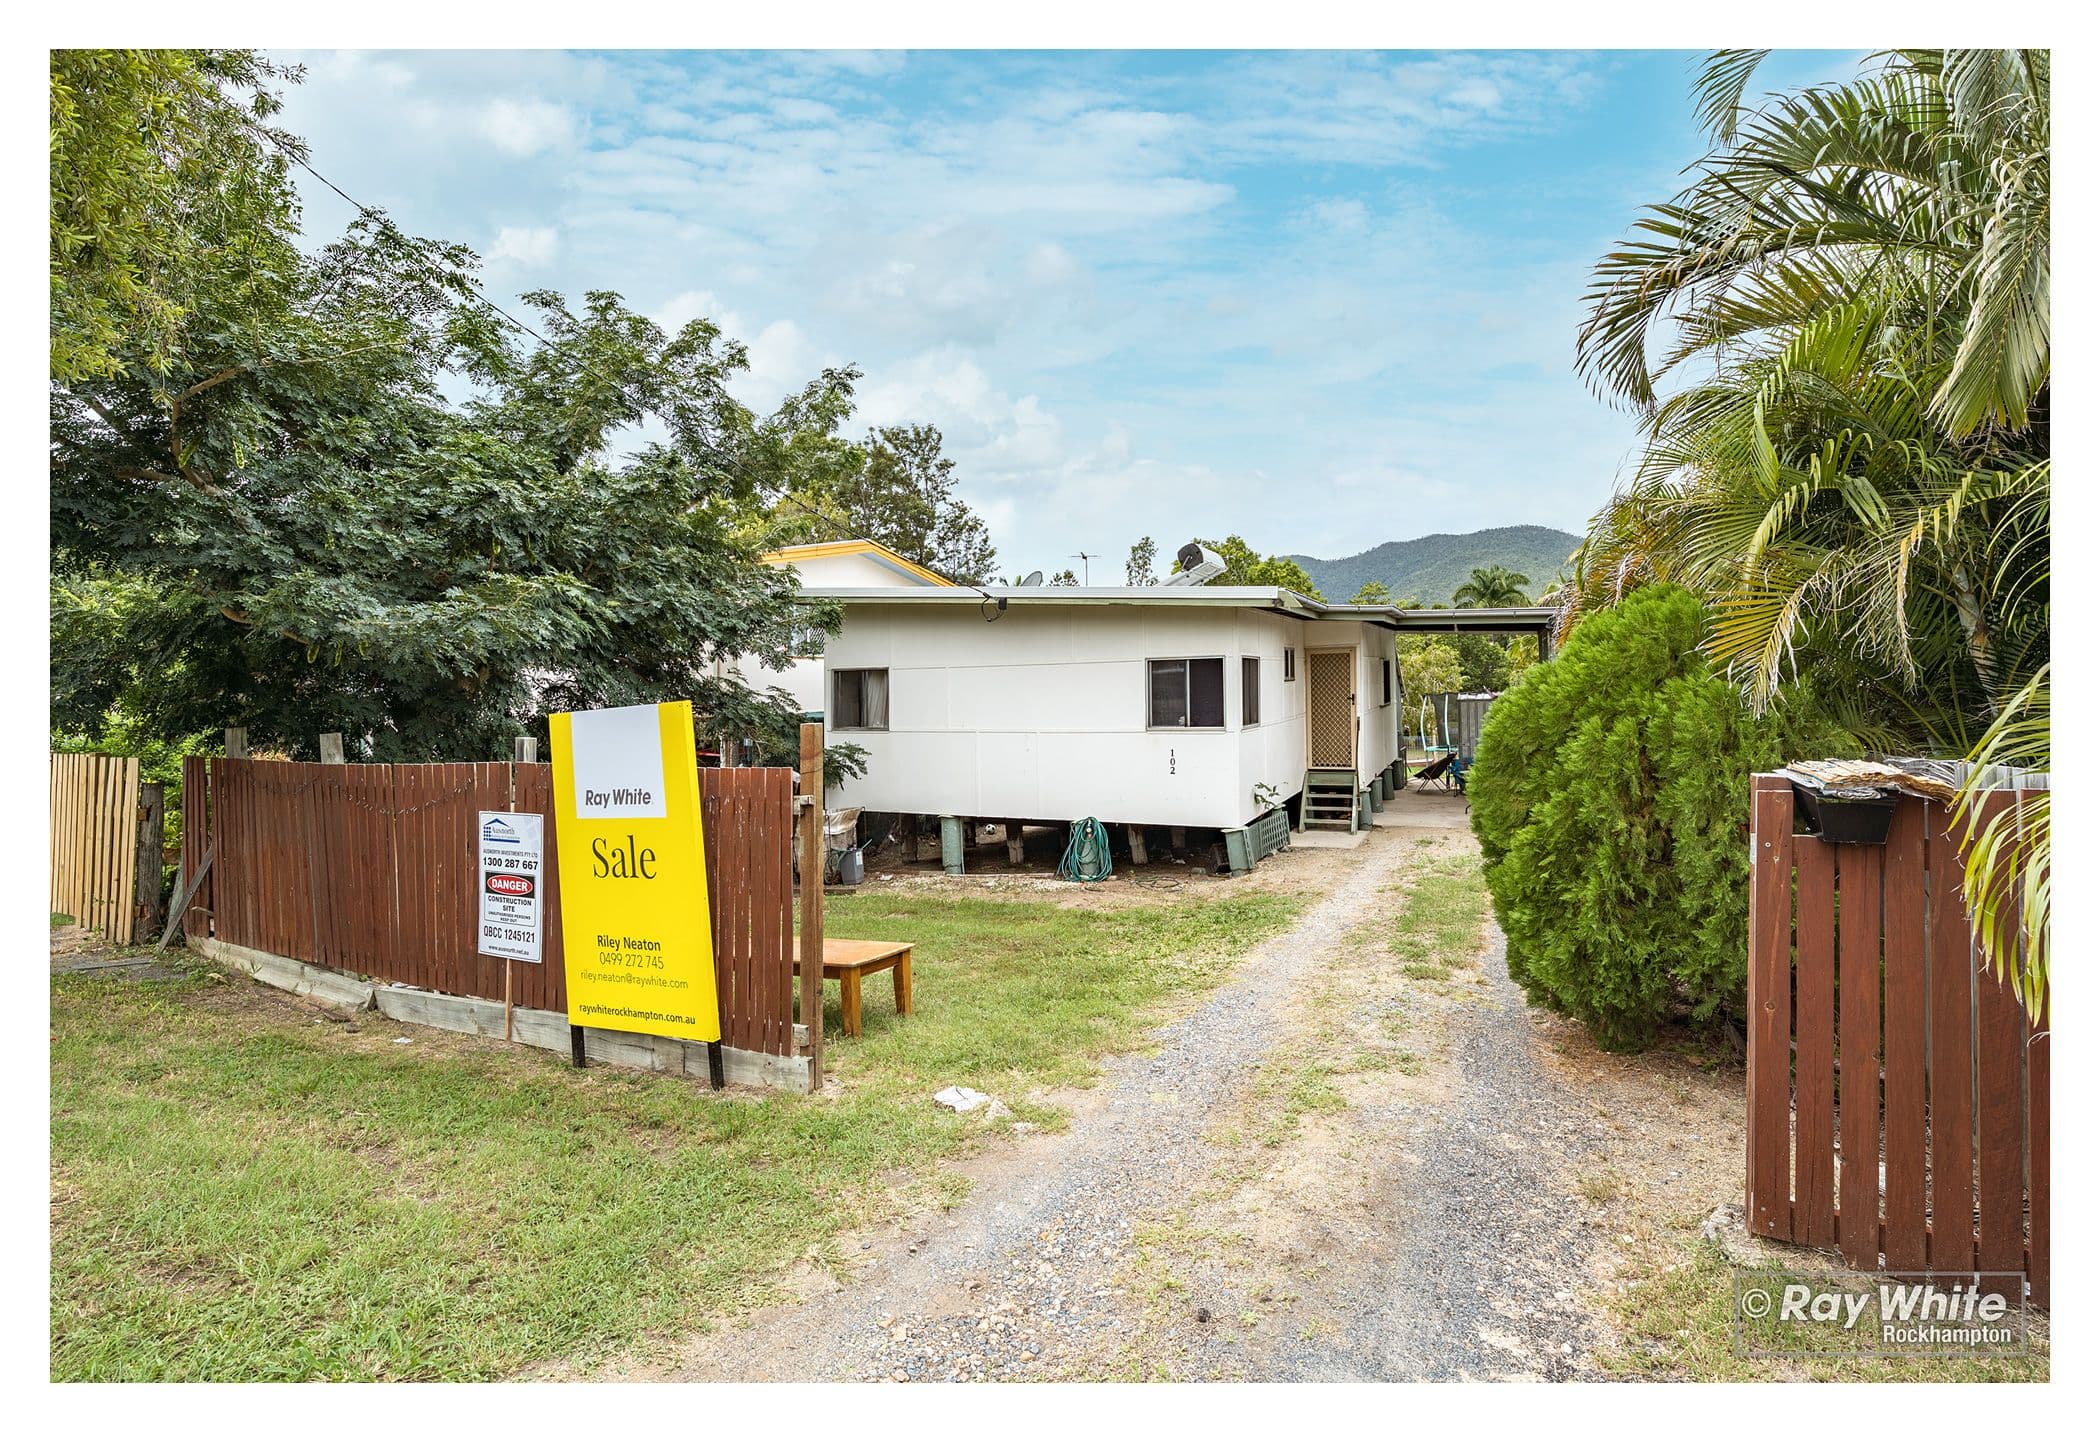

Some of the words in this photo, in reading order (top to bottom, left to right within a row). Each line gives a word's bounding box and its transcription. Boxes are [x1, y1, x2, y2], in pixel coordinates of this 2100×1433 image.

[585, 789, 610, 808] Ray
[612, 787, 652, 807] White
[483, 857, 502, 868] 1300
[505, 858, 520, 869] 287
[522, 860, 538, 871] 667
[592, 834, 657, 880] Sale
[491, 878, 528, 892] DANGER
[488, 895, 532, 906] CONSTRUCTION
[483, 925, 502, 938] QBCC
[504, 929, 535, 943] 1245121
[597, 935, 621, 951] Riley
[623, 936, 661, 952] Neaton
[599, 951, 624, 967] 0499
[625, 953, 644, 968] 272
[645, 955, 664, 970] 745
[580, 970, 688, 990] riley.neaton@raywhite.com
[579, 1002, 696, 1025] raywhiterockhampton.com.au
